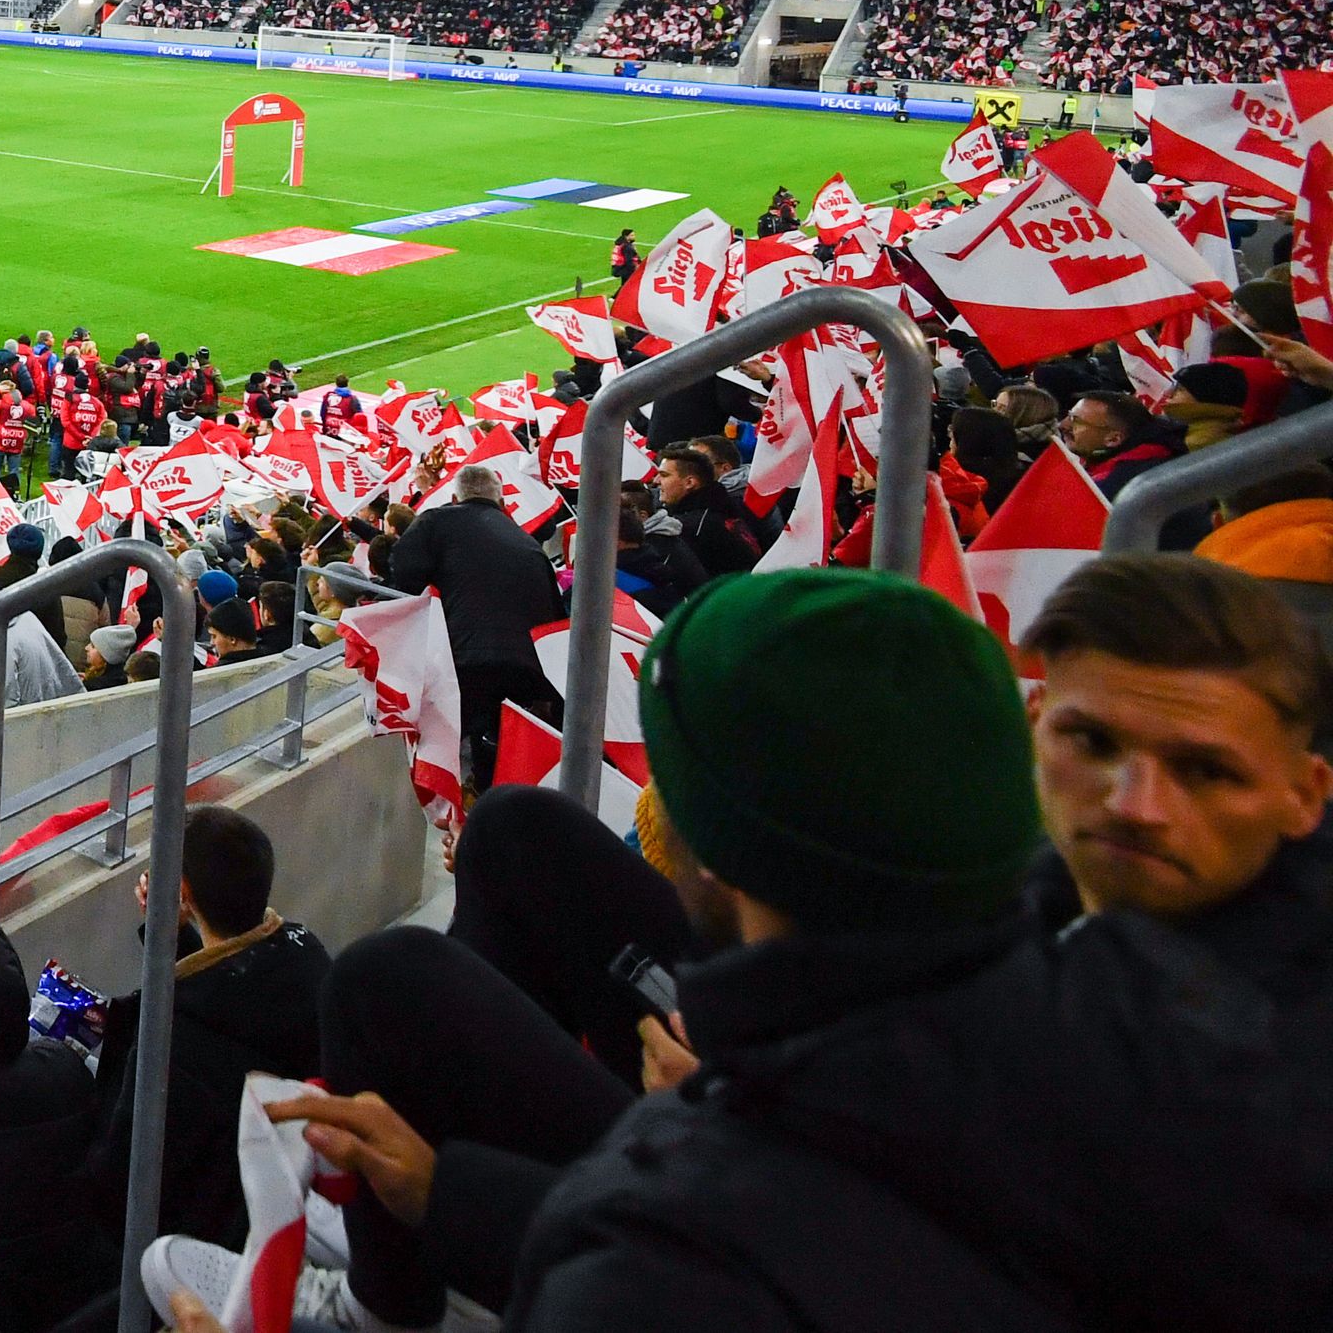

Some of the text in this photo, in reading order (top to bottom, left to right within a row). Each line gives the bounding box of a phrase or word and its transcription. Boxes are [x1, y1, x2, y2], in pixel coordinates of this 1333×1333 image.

[35, 37, 57, 46] PEACE
[158, 47, 185, 56] PEACE
[451, 69, 482, 79] PEACE
[494, 71, 519, 82] МИР
[624, 82, 661, 94] PEACE
[673, 86, 702, 97] МИР
[820, 97, 861, 110] PEACE
[653, 238, 695, 307] Stiegl
[75, 412, 97, 423] PHOTO
[759, 399, 784, 445] iegl
[1, 429, 25, 439] PHOTO
